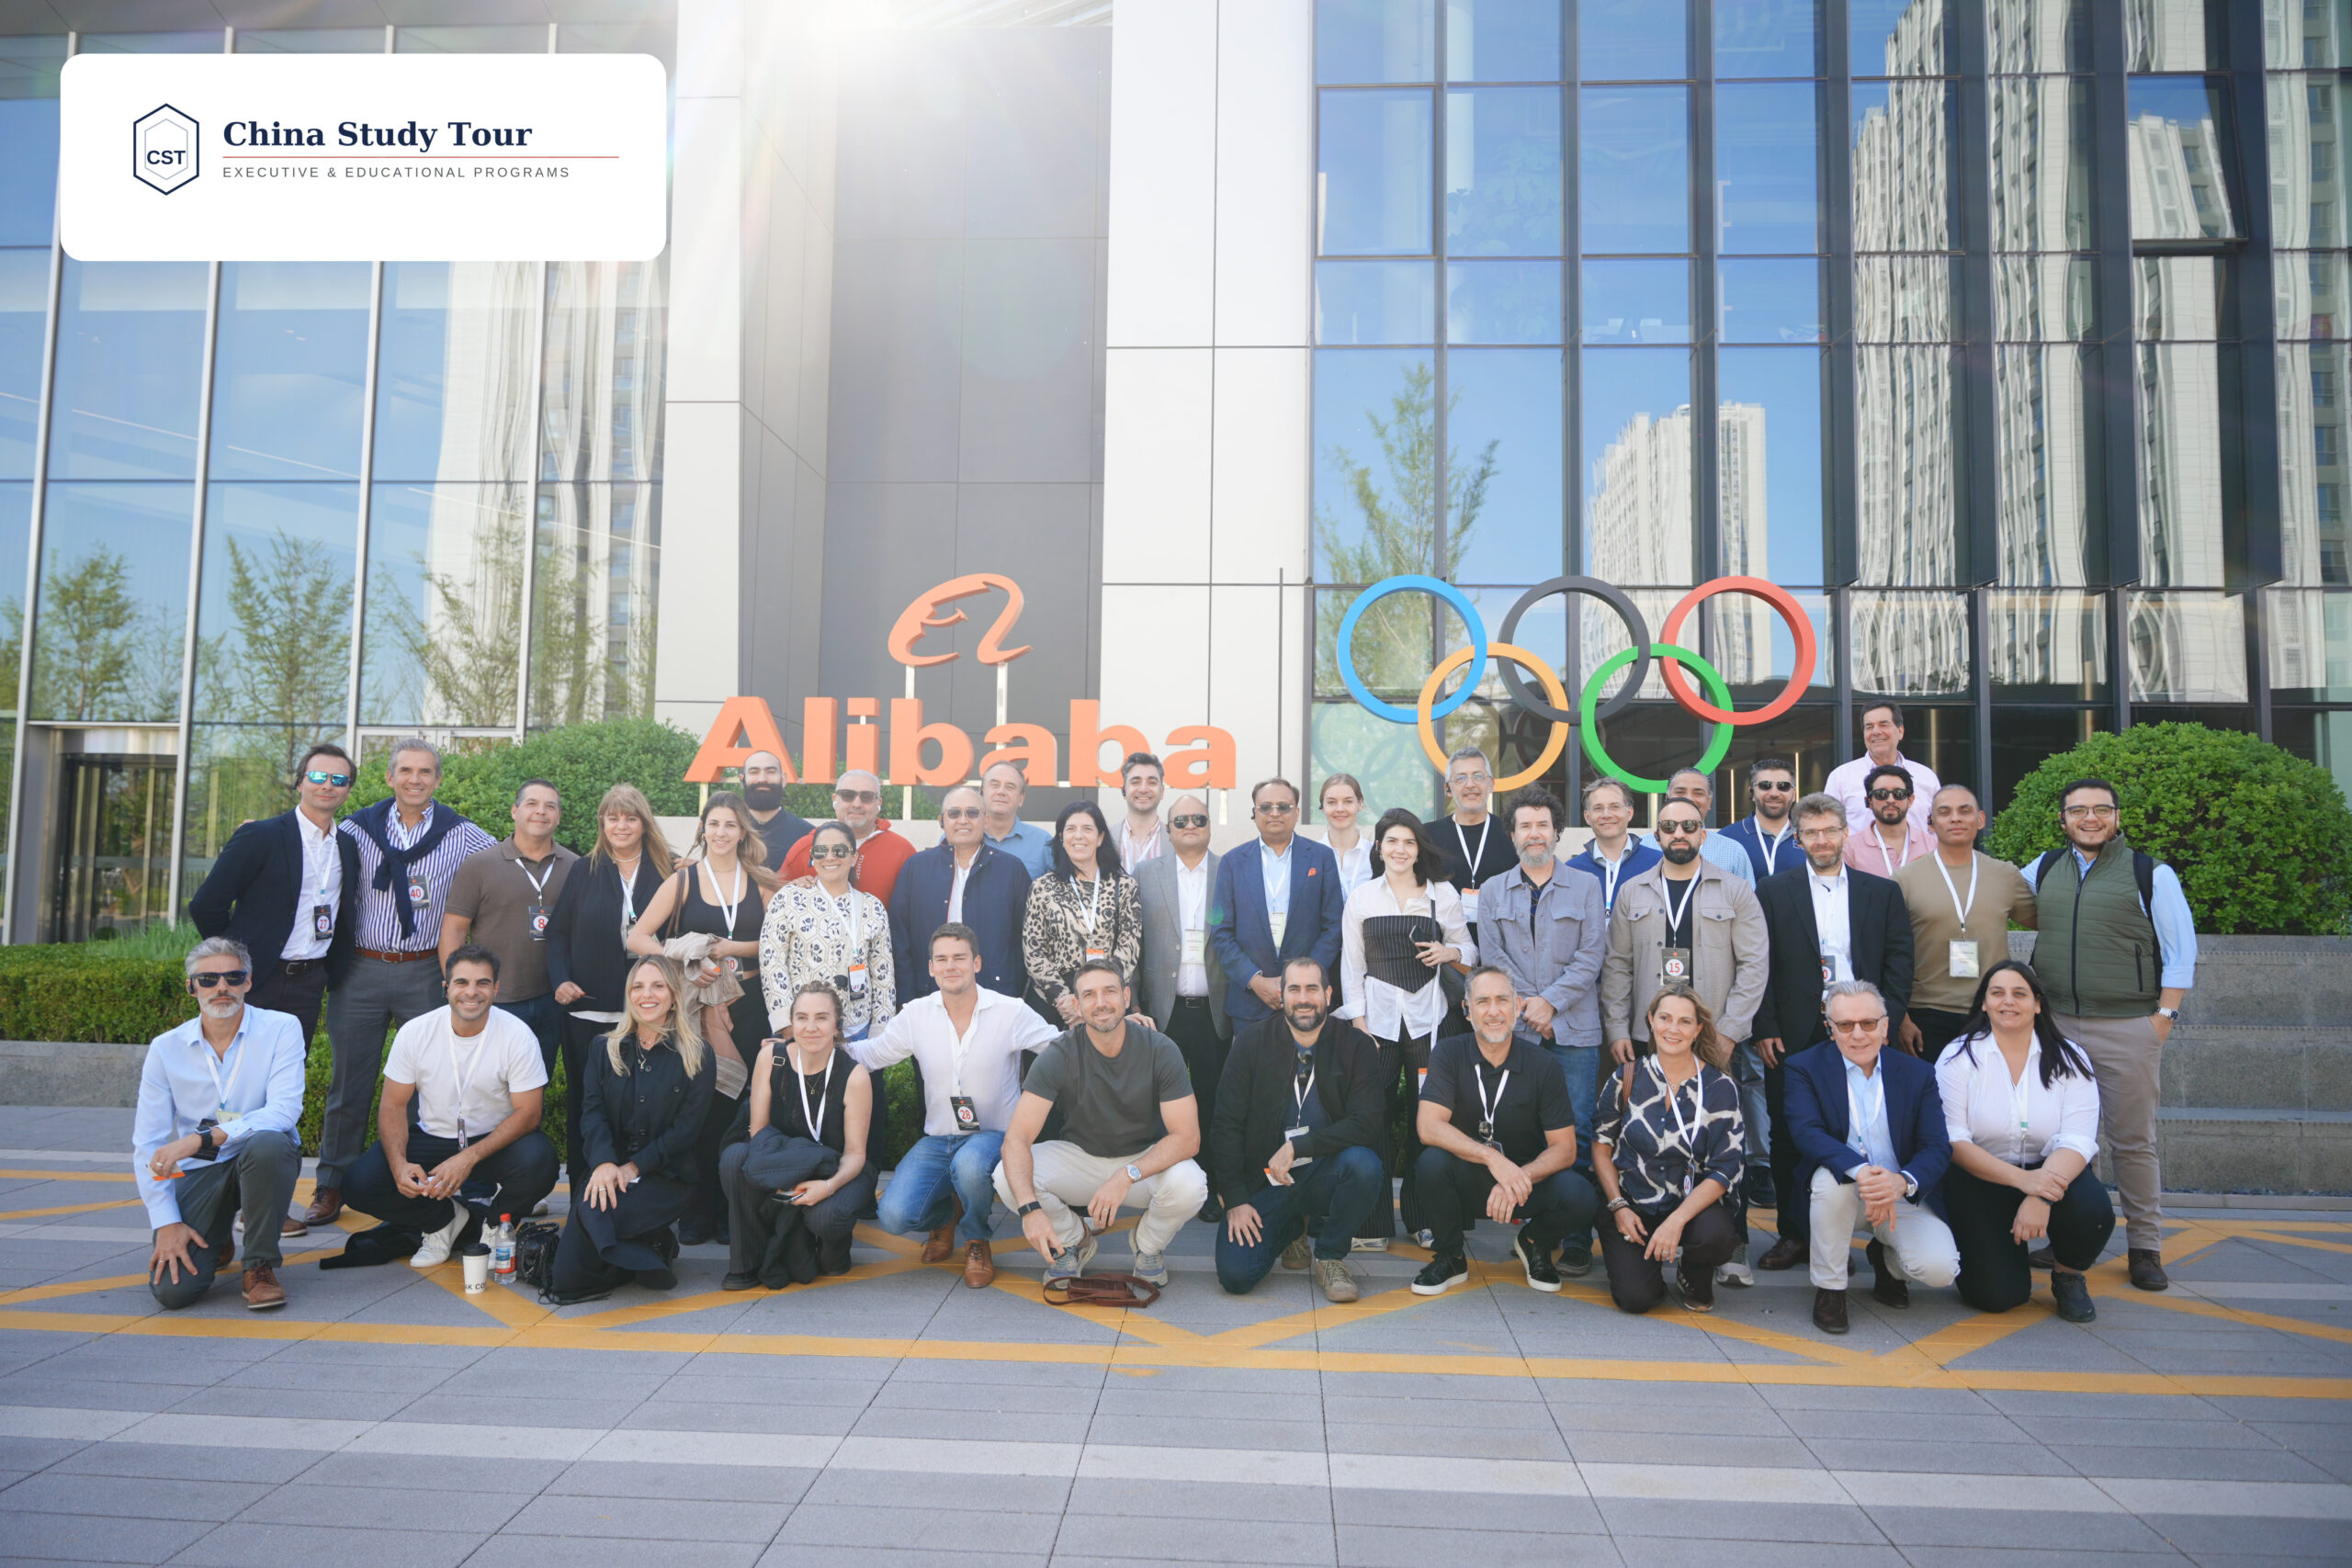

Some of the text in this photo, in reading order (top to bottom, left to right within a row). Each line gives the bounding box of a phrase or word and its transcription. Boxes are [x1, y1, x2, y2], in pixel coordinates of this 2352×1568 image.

[684, 696, 1237, 790] Alibaba
[411, 888, 422, 898] 40
[320, 919, 328, 930] 27
[538, 918, 547, 930] 8
[1668, 963, 1680, 974] 15
[960, 1109, 972, 1120] 28
